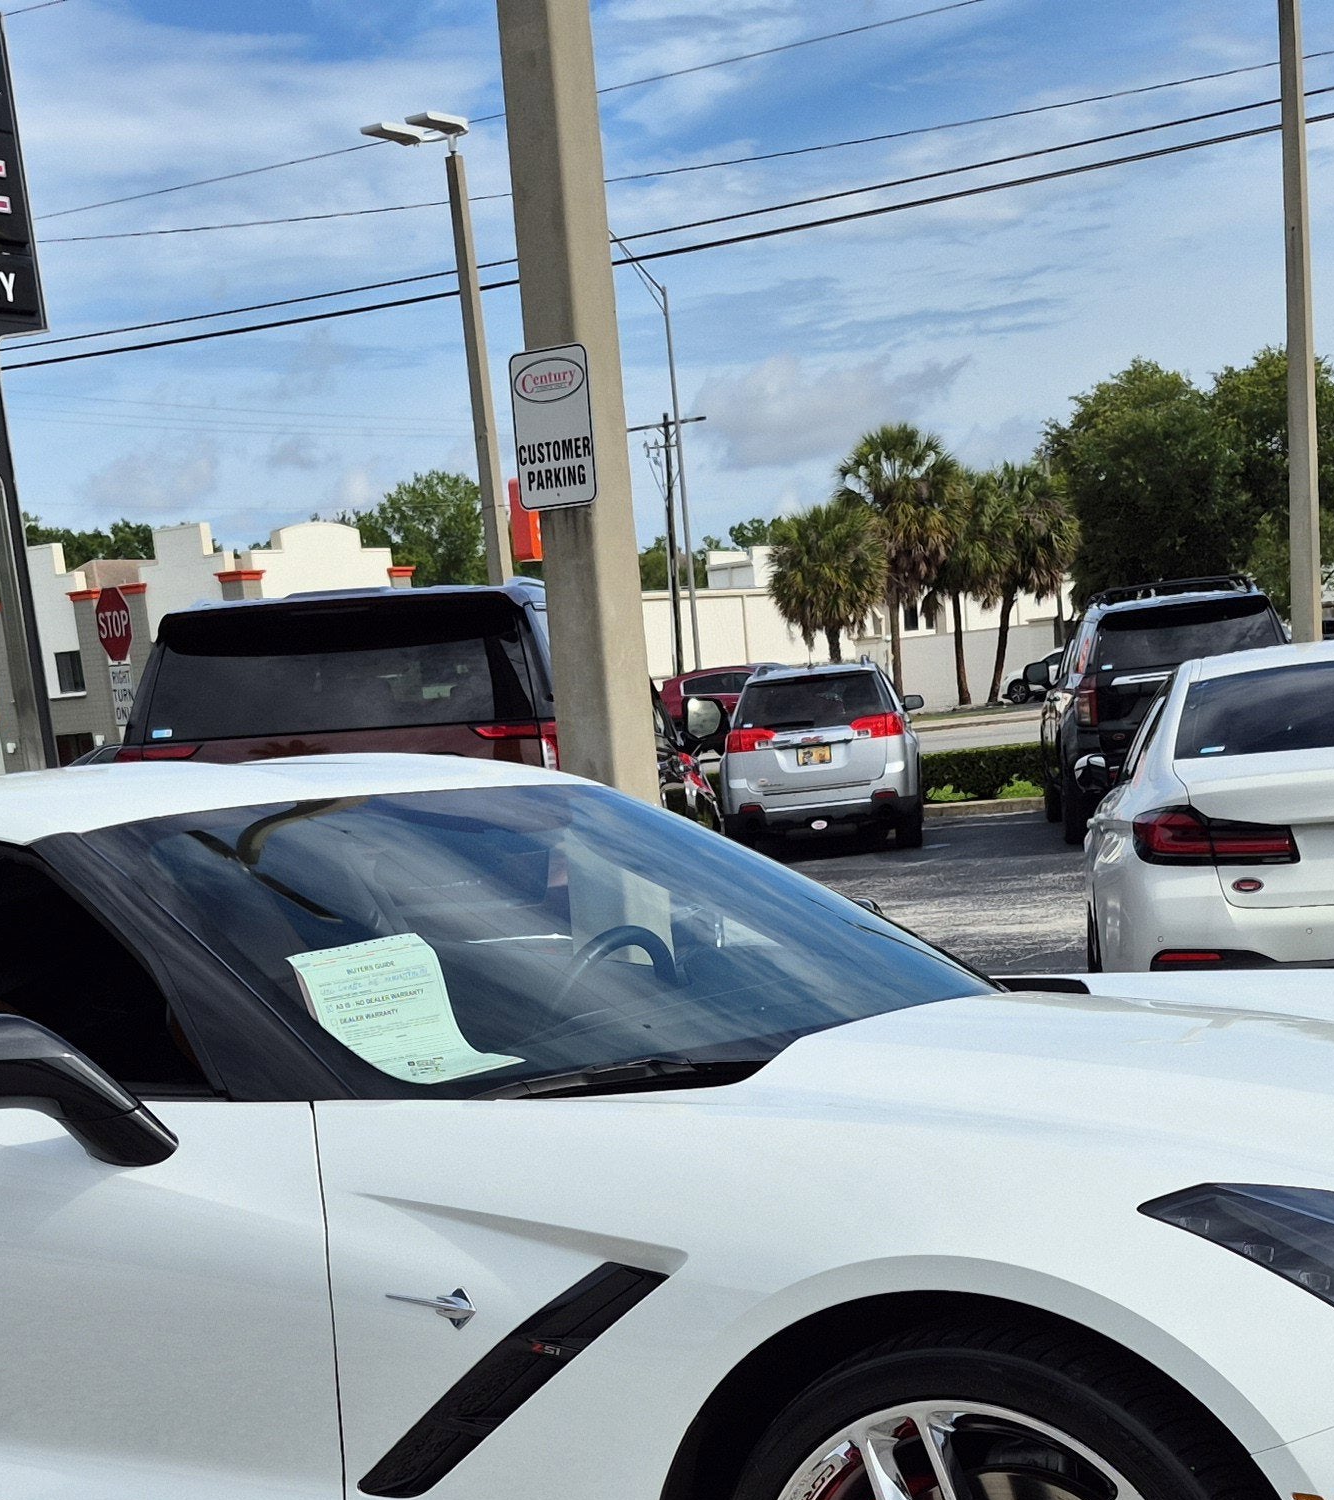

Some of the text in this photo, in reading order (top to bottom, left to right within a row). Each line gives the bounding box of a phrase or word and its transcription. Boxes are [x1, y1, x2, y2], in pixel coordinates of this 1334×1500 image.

[521, 368, 576, 394] Century
[519, 436, 592, 466] CUSTOMER
[527, 464, 587, 492] PARKING
[98, 610, 129, 639] STOP
